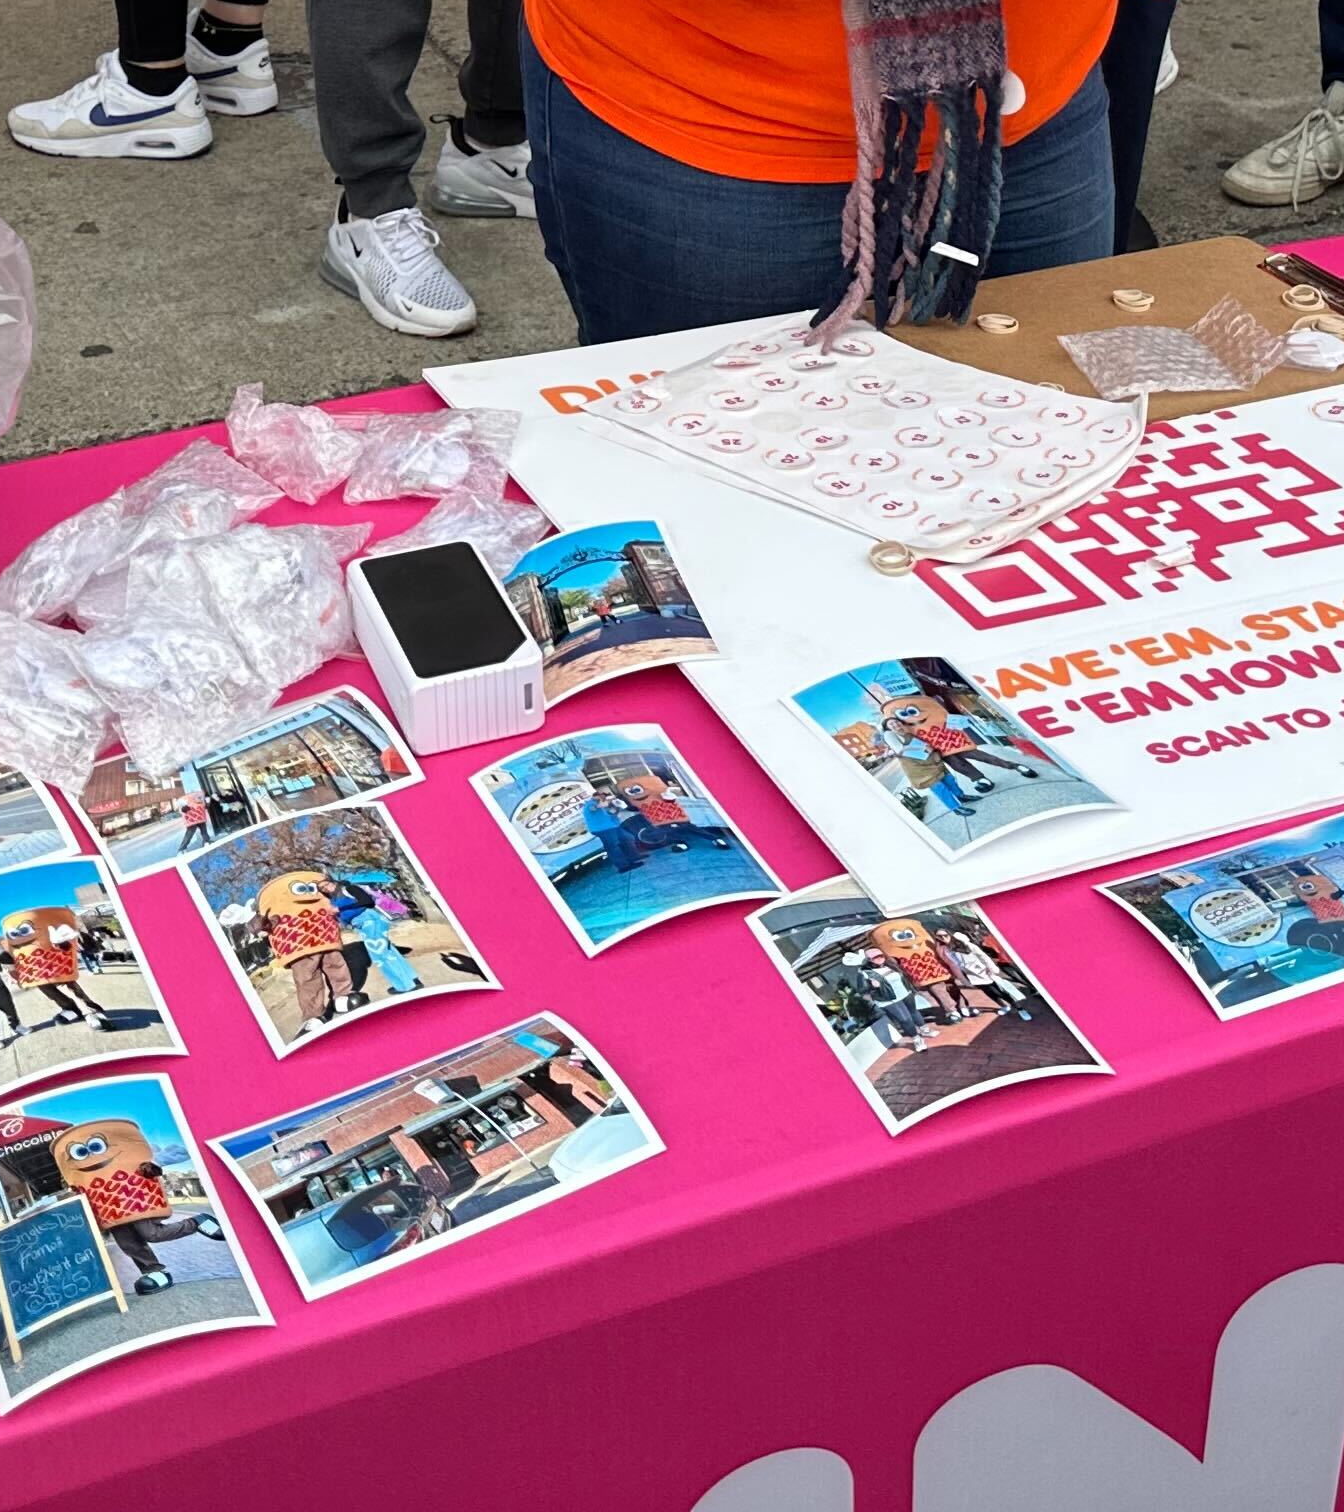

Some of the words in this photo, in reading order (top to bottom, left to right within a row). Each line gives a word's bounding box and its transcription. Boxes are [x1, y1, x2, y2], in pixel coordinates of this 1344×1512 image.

[1180, 644, 1342, 701] HOW
[1146, 721, 1270, 764] SCAN
[1262, 708, 1331, 735] TO
